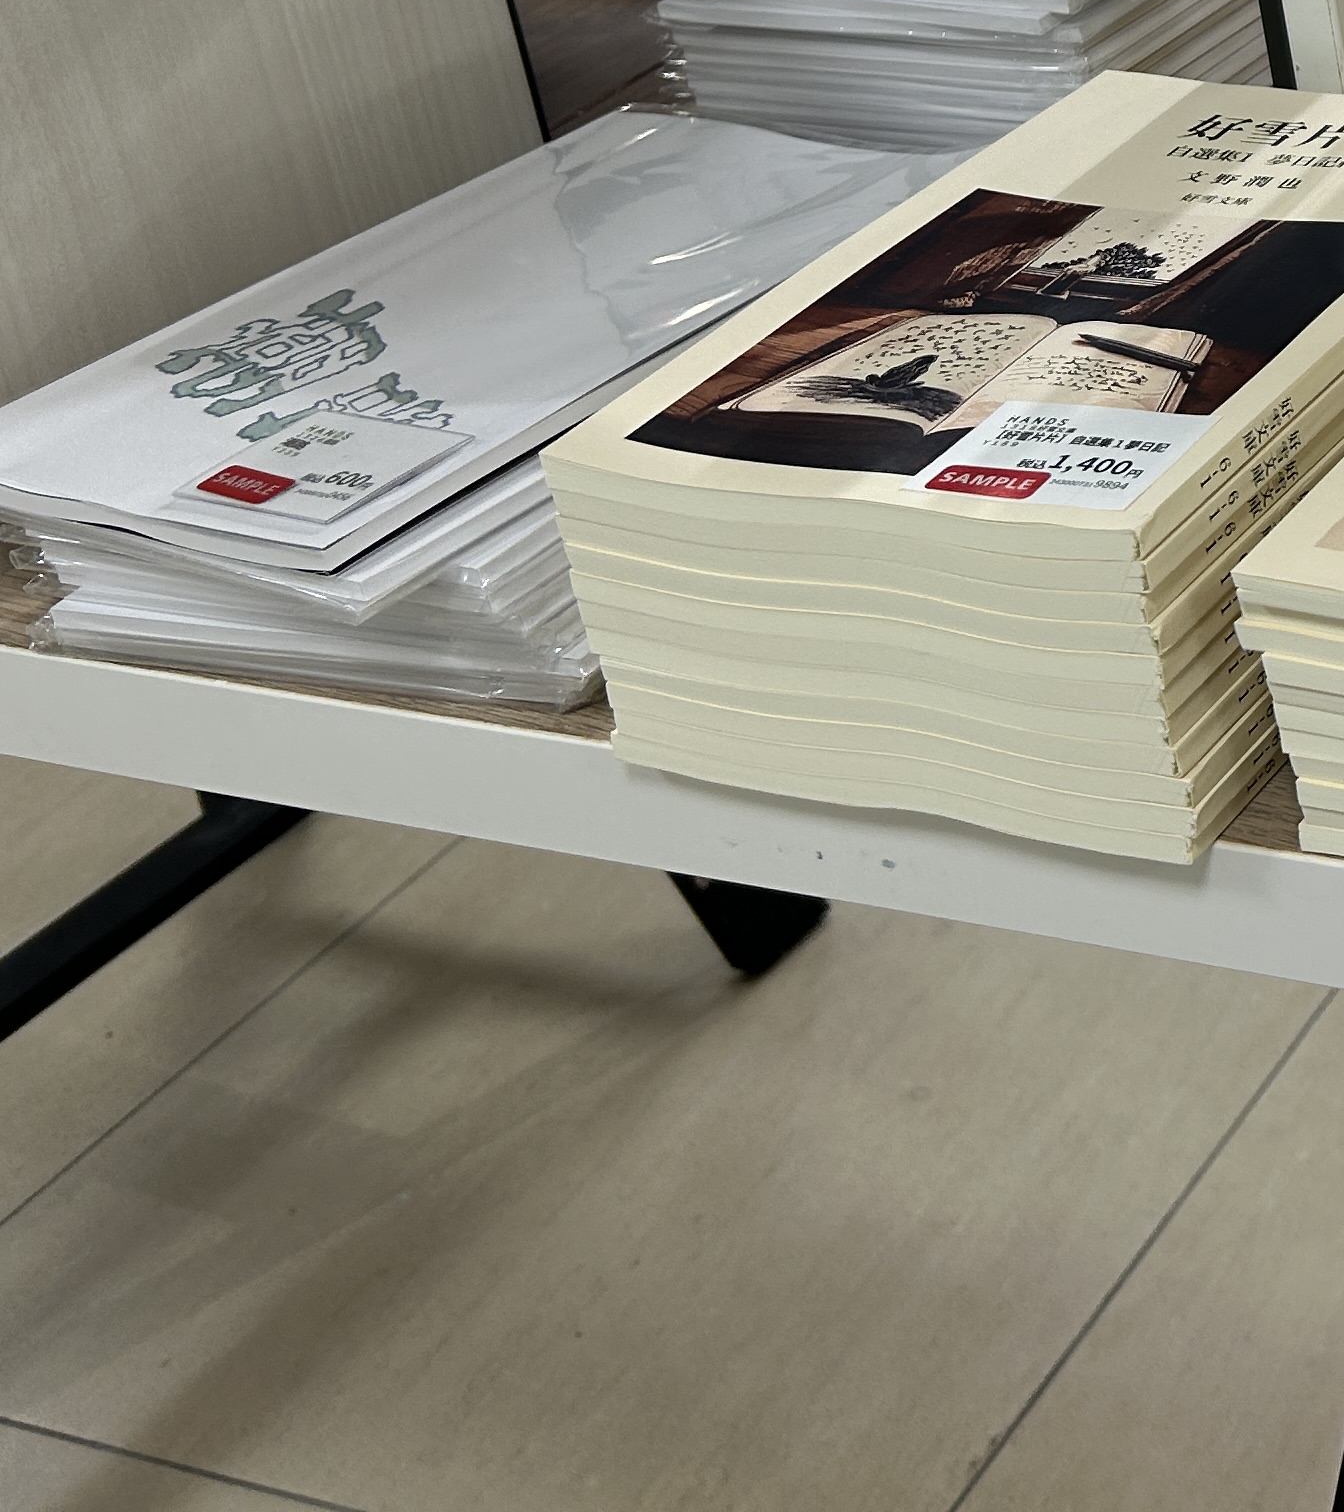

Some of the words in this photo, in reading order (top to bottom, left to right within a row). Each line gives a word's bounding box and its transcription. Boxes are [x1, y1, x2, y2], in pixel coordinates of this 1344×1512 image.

[1181, 193, 1253, 206] 好雪文庫
[1006, 415, 1070, 426] HANDS
[212, 472, 280, 496] SAMPLE
[938, 471, 1037, 491] SAMPLE
